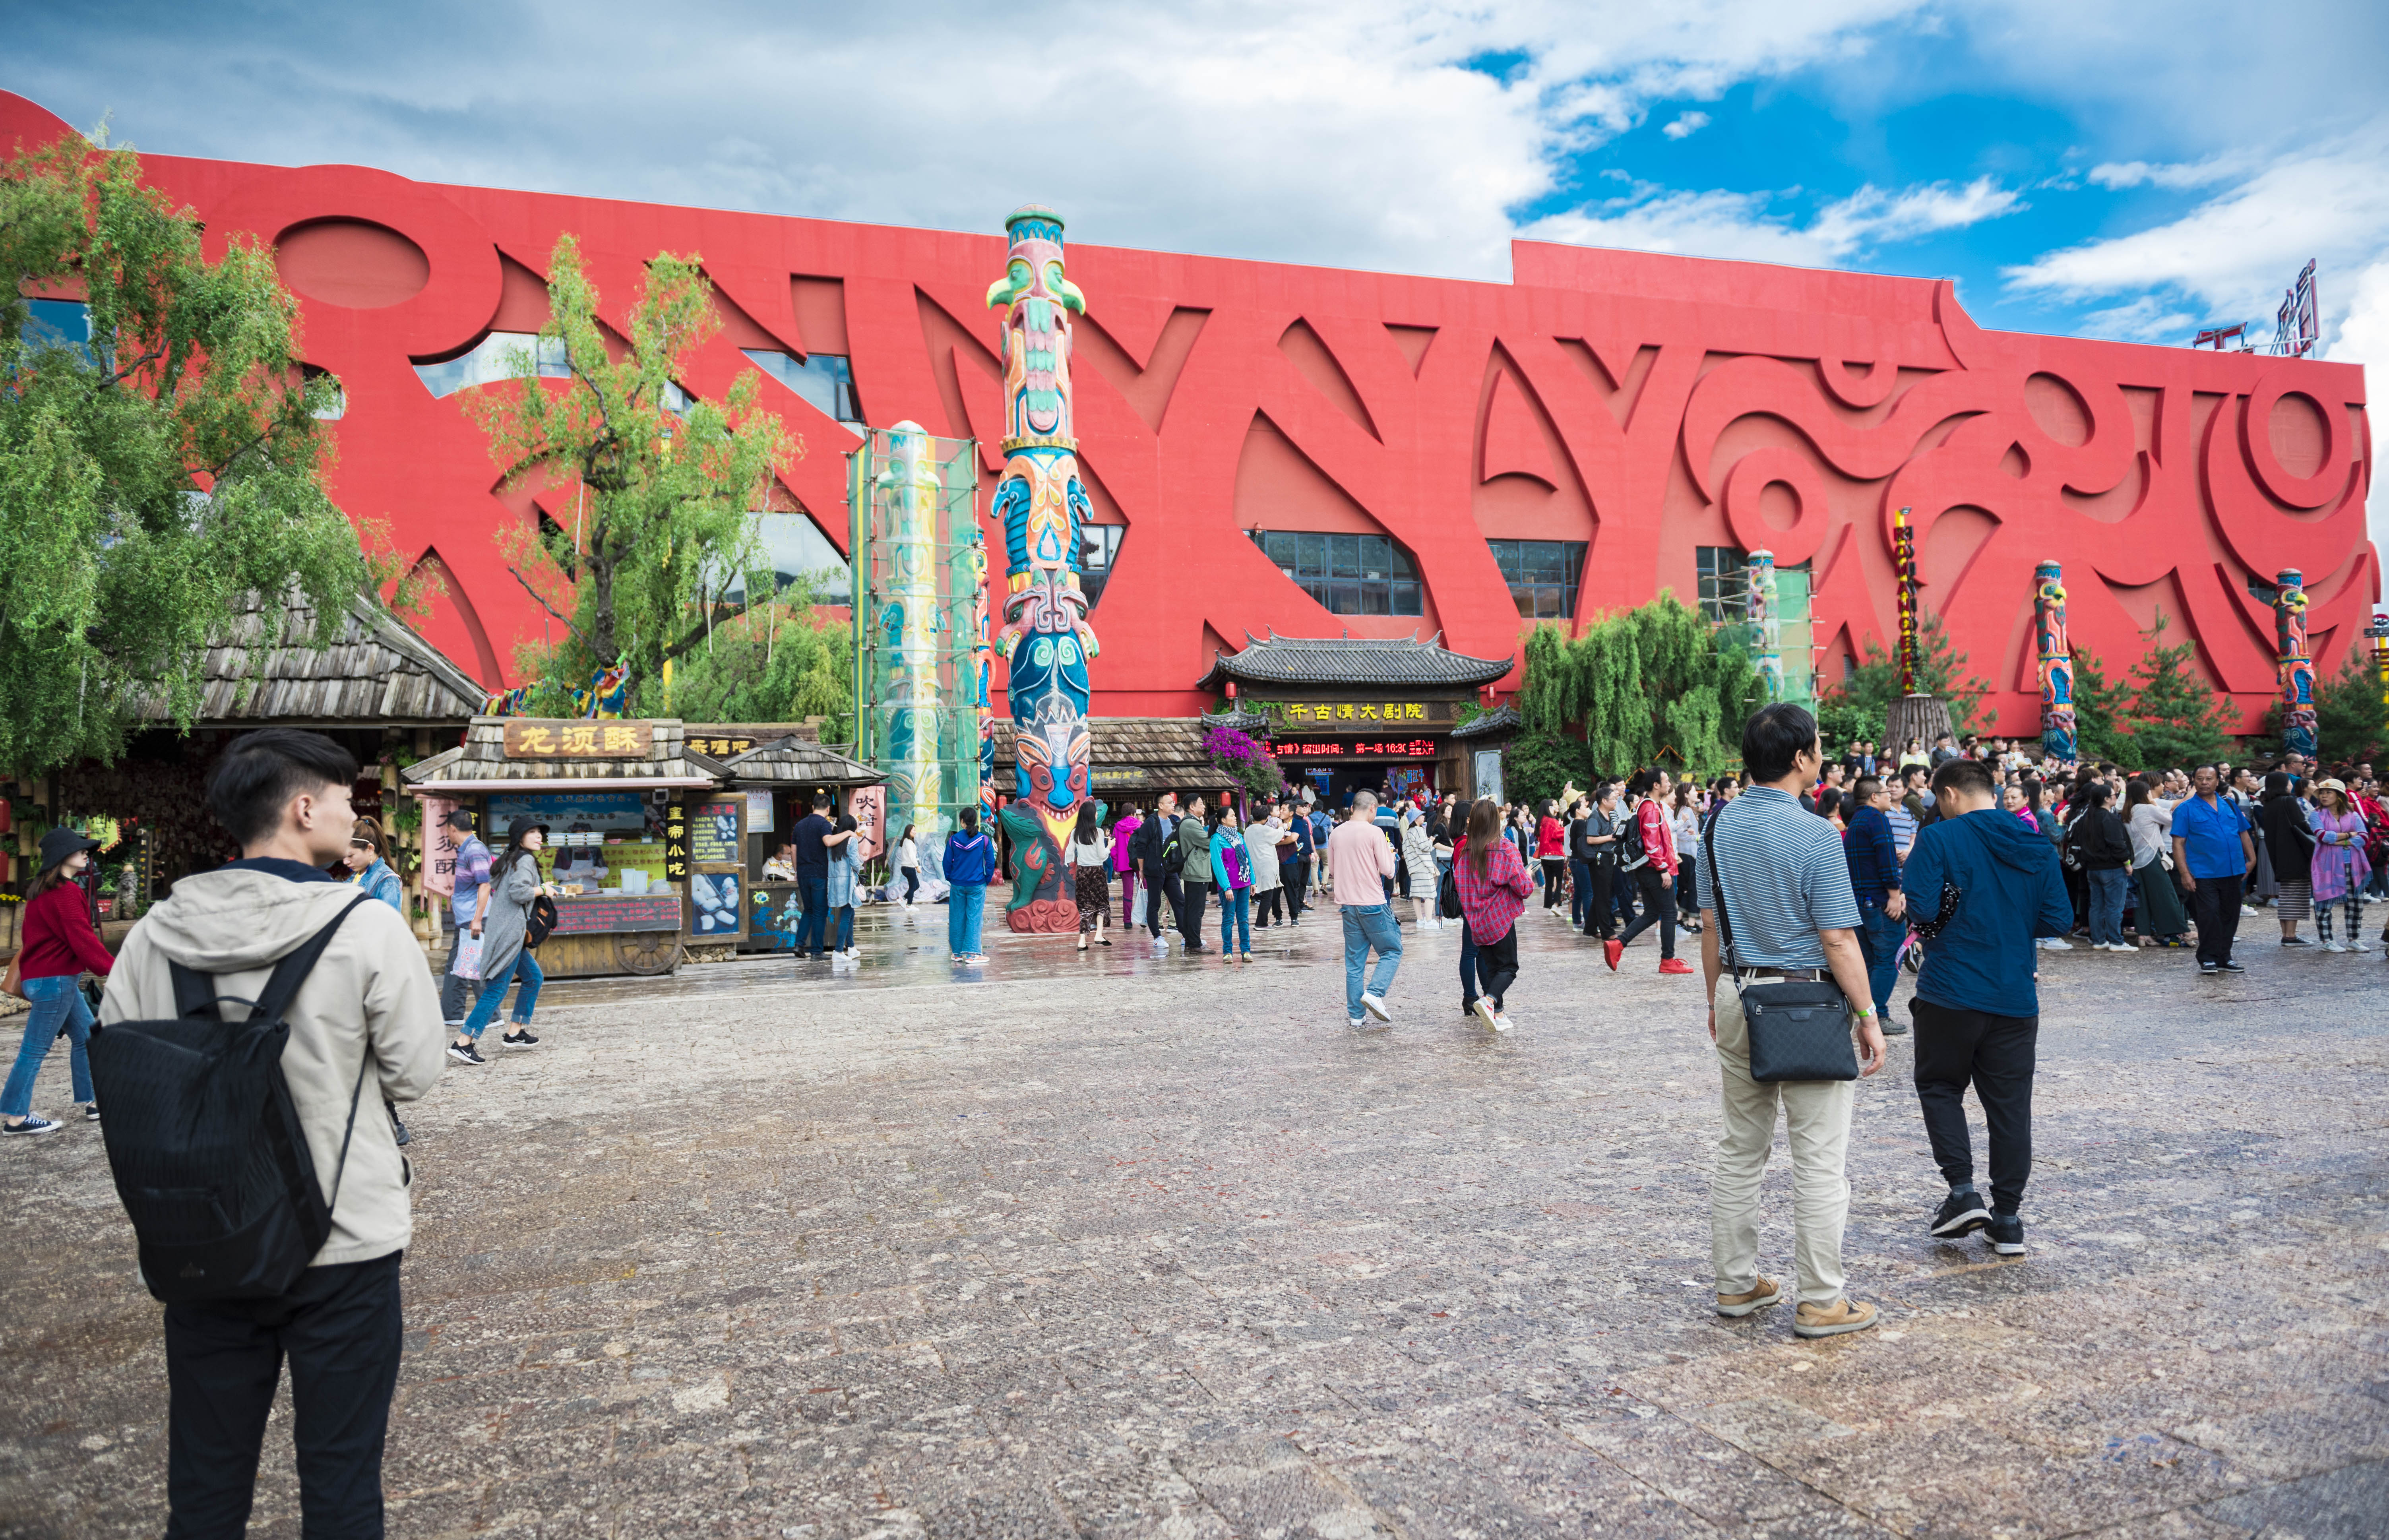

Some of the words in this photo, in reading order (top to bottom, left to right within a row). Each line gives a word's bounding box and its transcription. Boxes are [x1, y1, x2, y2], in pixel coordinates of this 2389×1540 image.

[1290, 703, 1424, 720] 千古情大剧院
[519, 726, 641, 753] 龙须酥
[667, 806, 686, 876] 皇帝小吃
